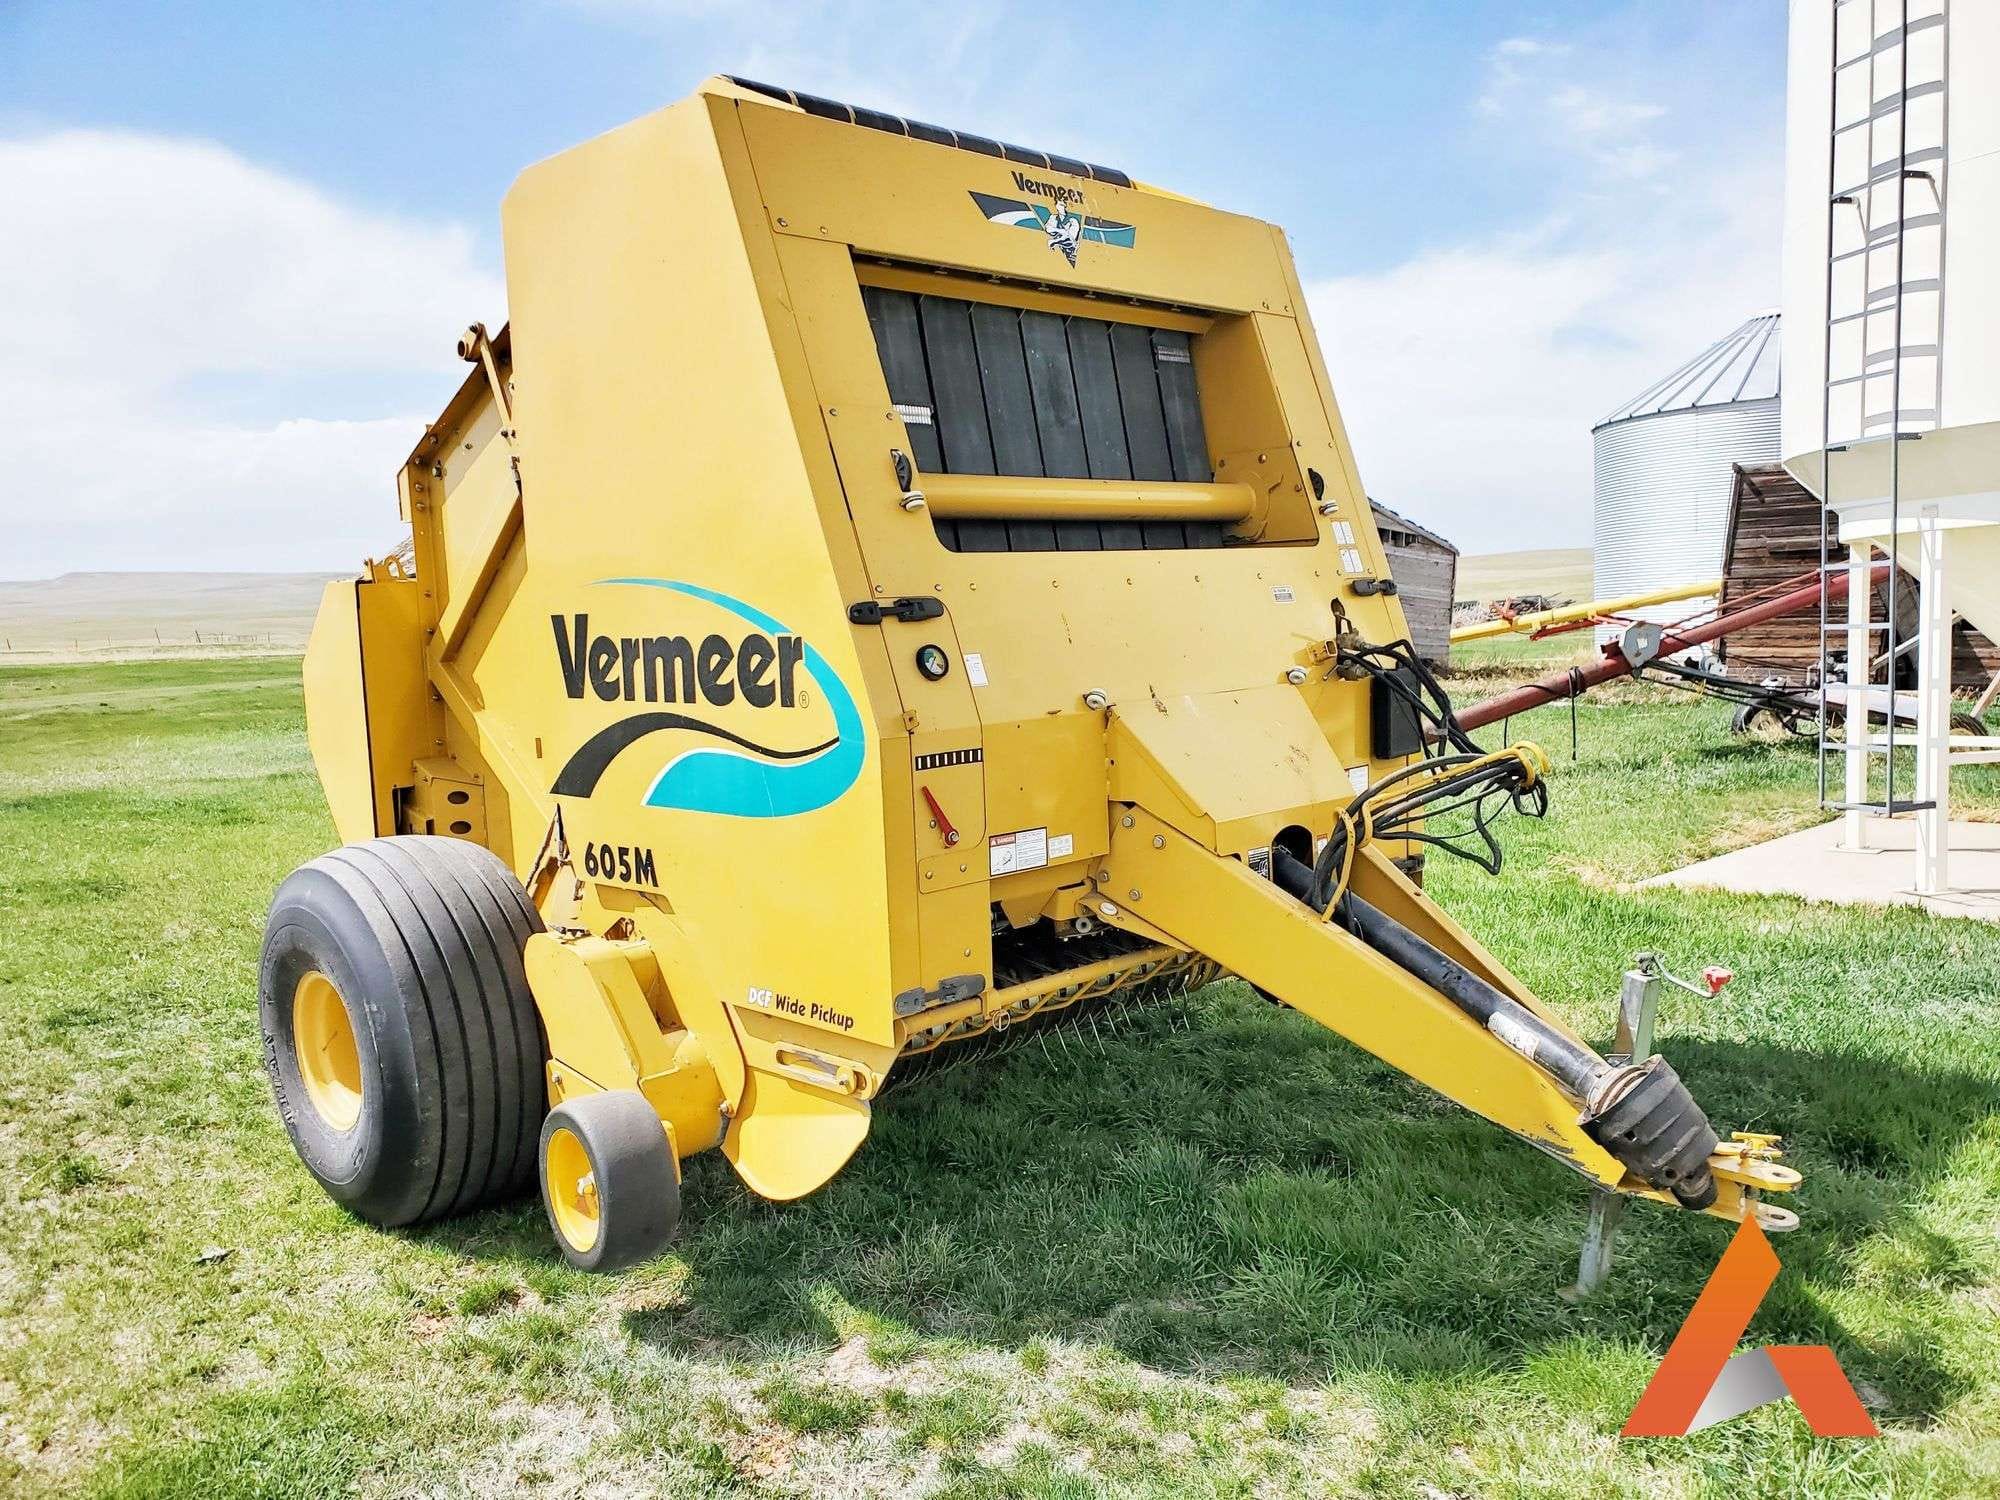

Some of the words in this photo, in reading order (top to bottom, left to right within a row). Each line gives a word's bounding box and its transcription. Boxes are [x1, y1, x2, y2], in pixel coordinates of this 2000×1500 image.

[1011, 170, 1083, 204] Vermeer
[550, 613, 804, 708] Vermeer
[584, 841, 659, 888] 605M
[748, 986, 773, 1008] DCF
[775, 993, 806, 1016] Wide
[810, 1002, 855, 1032] Pickup
